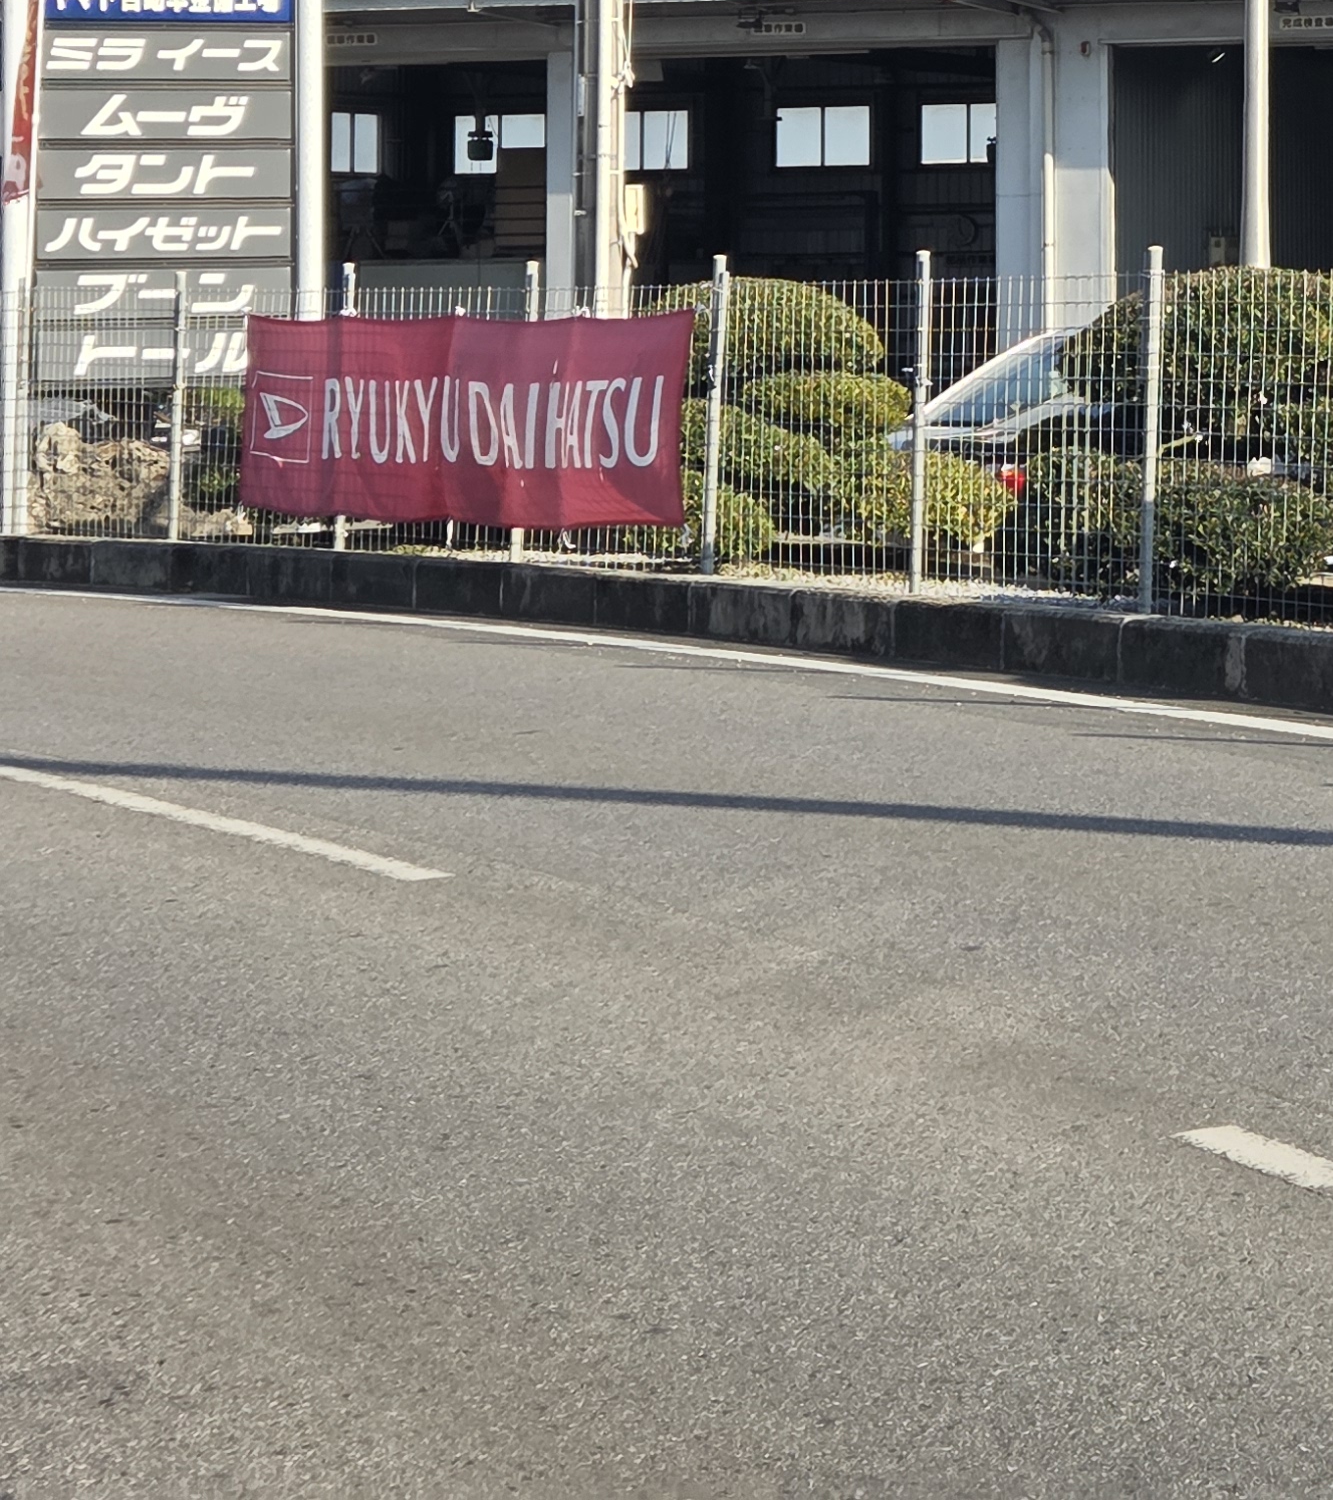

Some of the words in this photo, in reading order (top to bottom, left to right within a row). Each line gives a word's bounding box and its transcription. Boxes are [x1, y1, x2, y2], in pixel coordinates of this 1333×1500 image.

[80, 93, 248, 137] ムーヴ
[74, 153, 256, 195] タント
[44, 215, 283, 253] ハイゼット
[73, 272, 255, 315] ブーン
